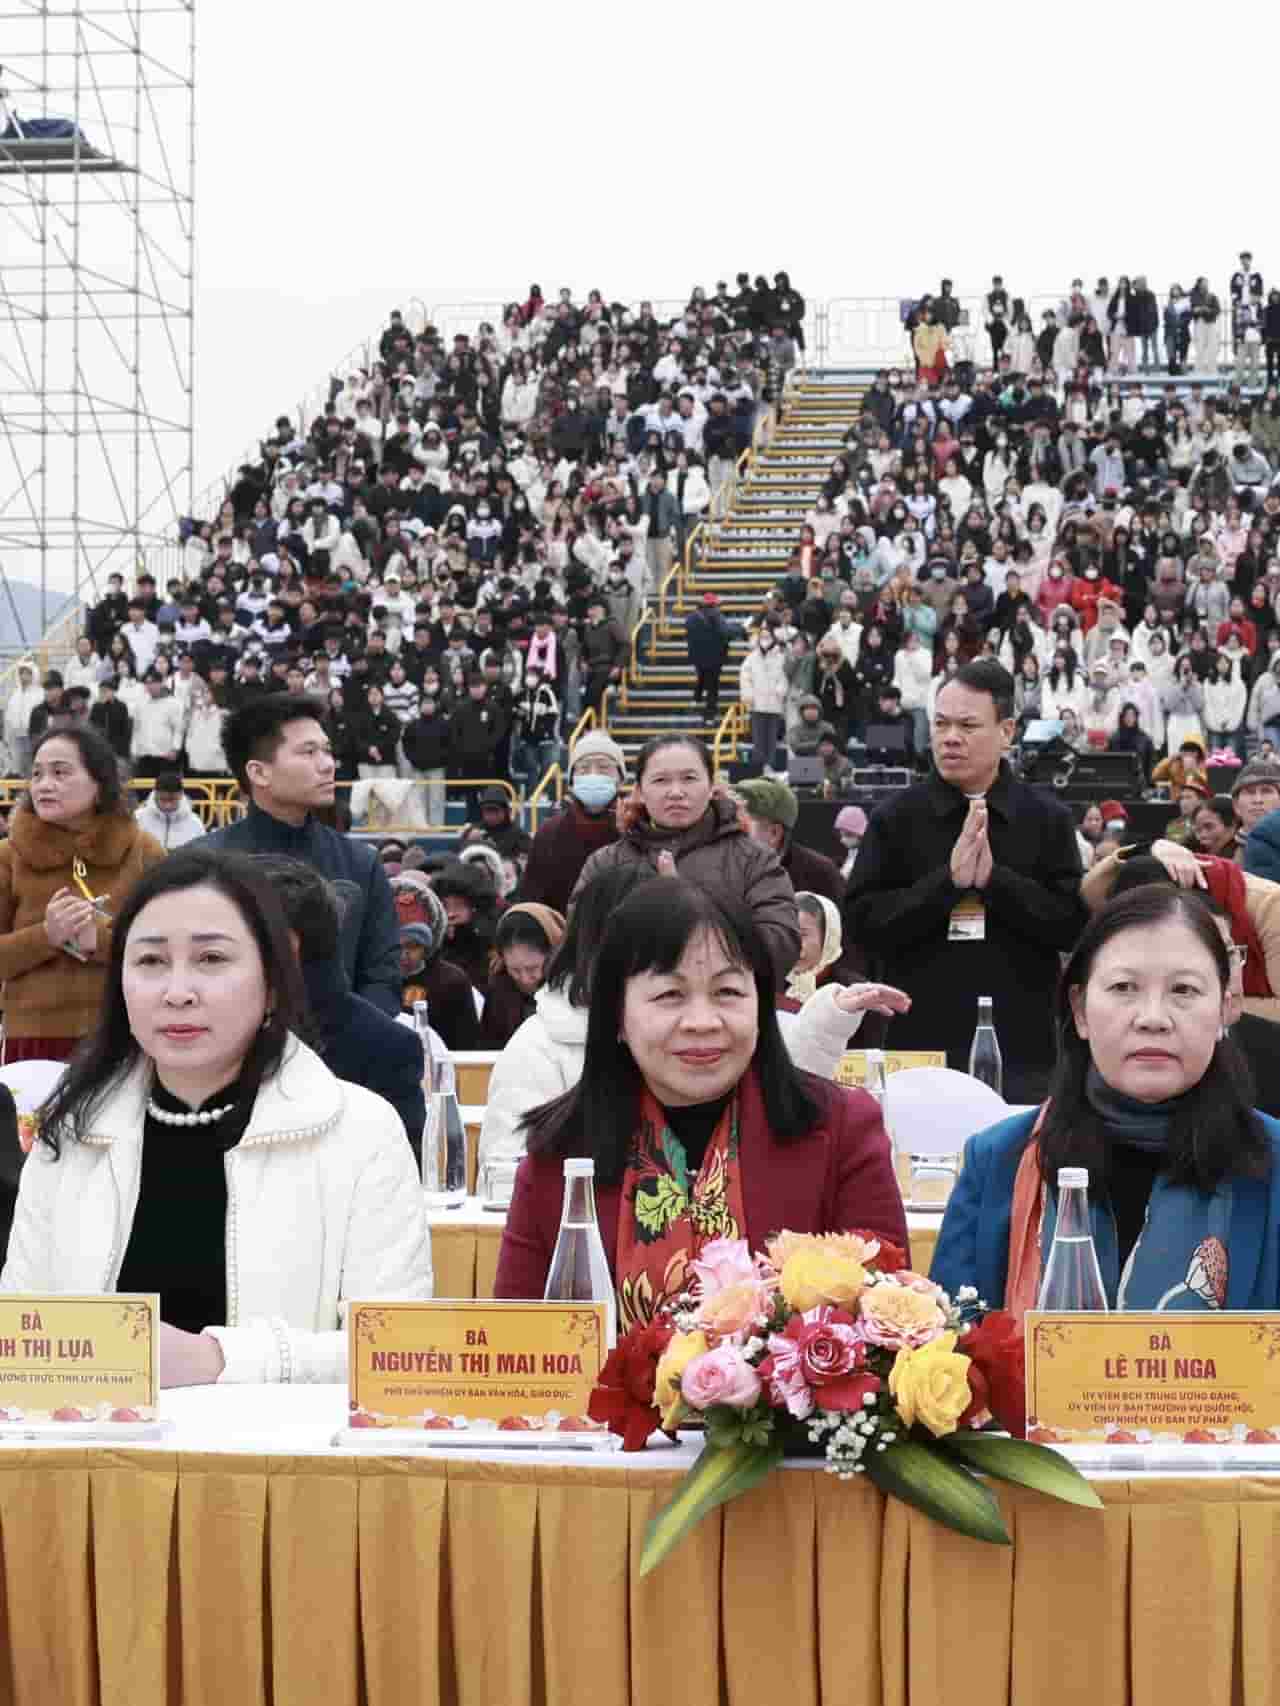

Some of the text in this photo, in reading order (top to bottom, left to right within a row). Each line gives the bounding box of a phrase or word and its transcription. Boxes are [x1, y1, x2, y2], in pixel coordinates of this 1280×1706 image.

[22, 1309, 43, 1330] BÀ
[22, 1339, 51, 1362] THỊ
[58, 1339, 94, 1362] LỤA
[1149, 1331, 1172, 1351] BÀ
[459, 1352, 489, 1377] THỊ
[496, 1352, 535, 1374] MAI
[543, 1353, 583, 1374] HOA
[1105, 1353, 1217, 1383] LÊ THỊ NGA
